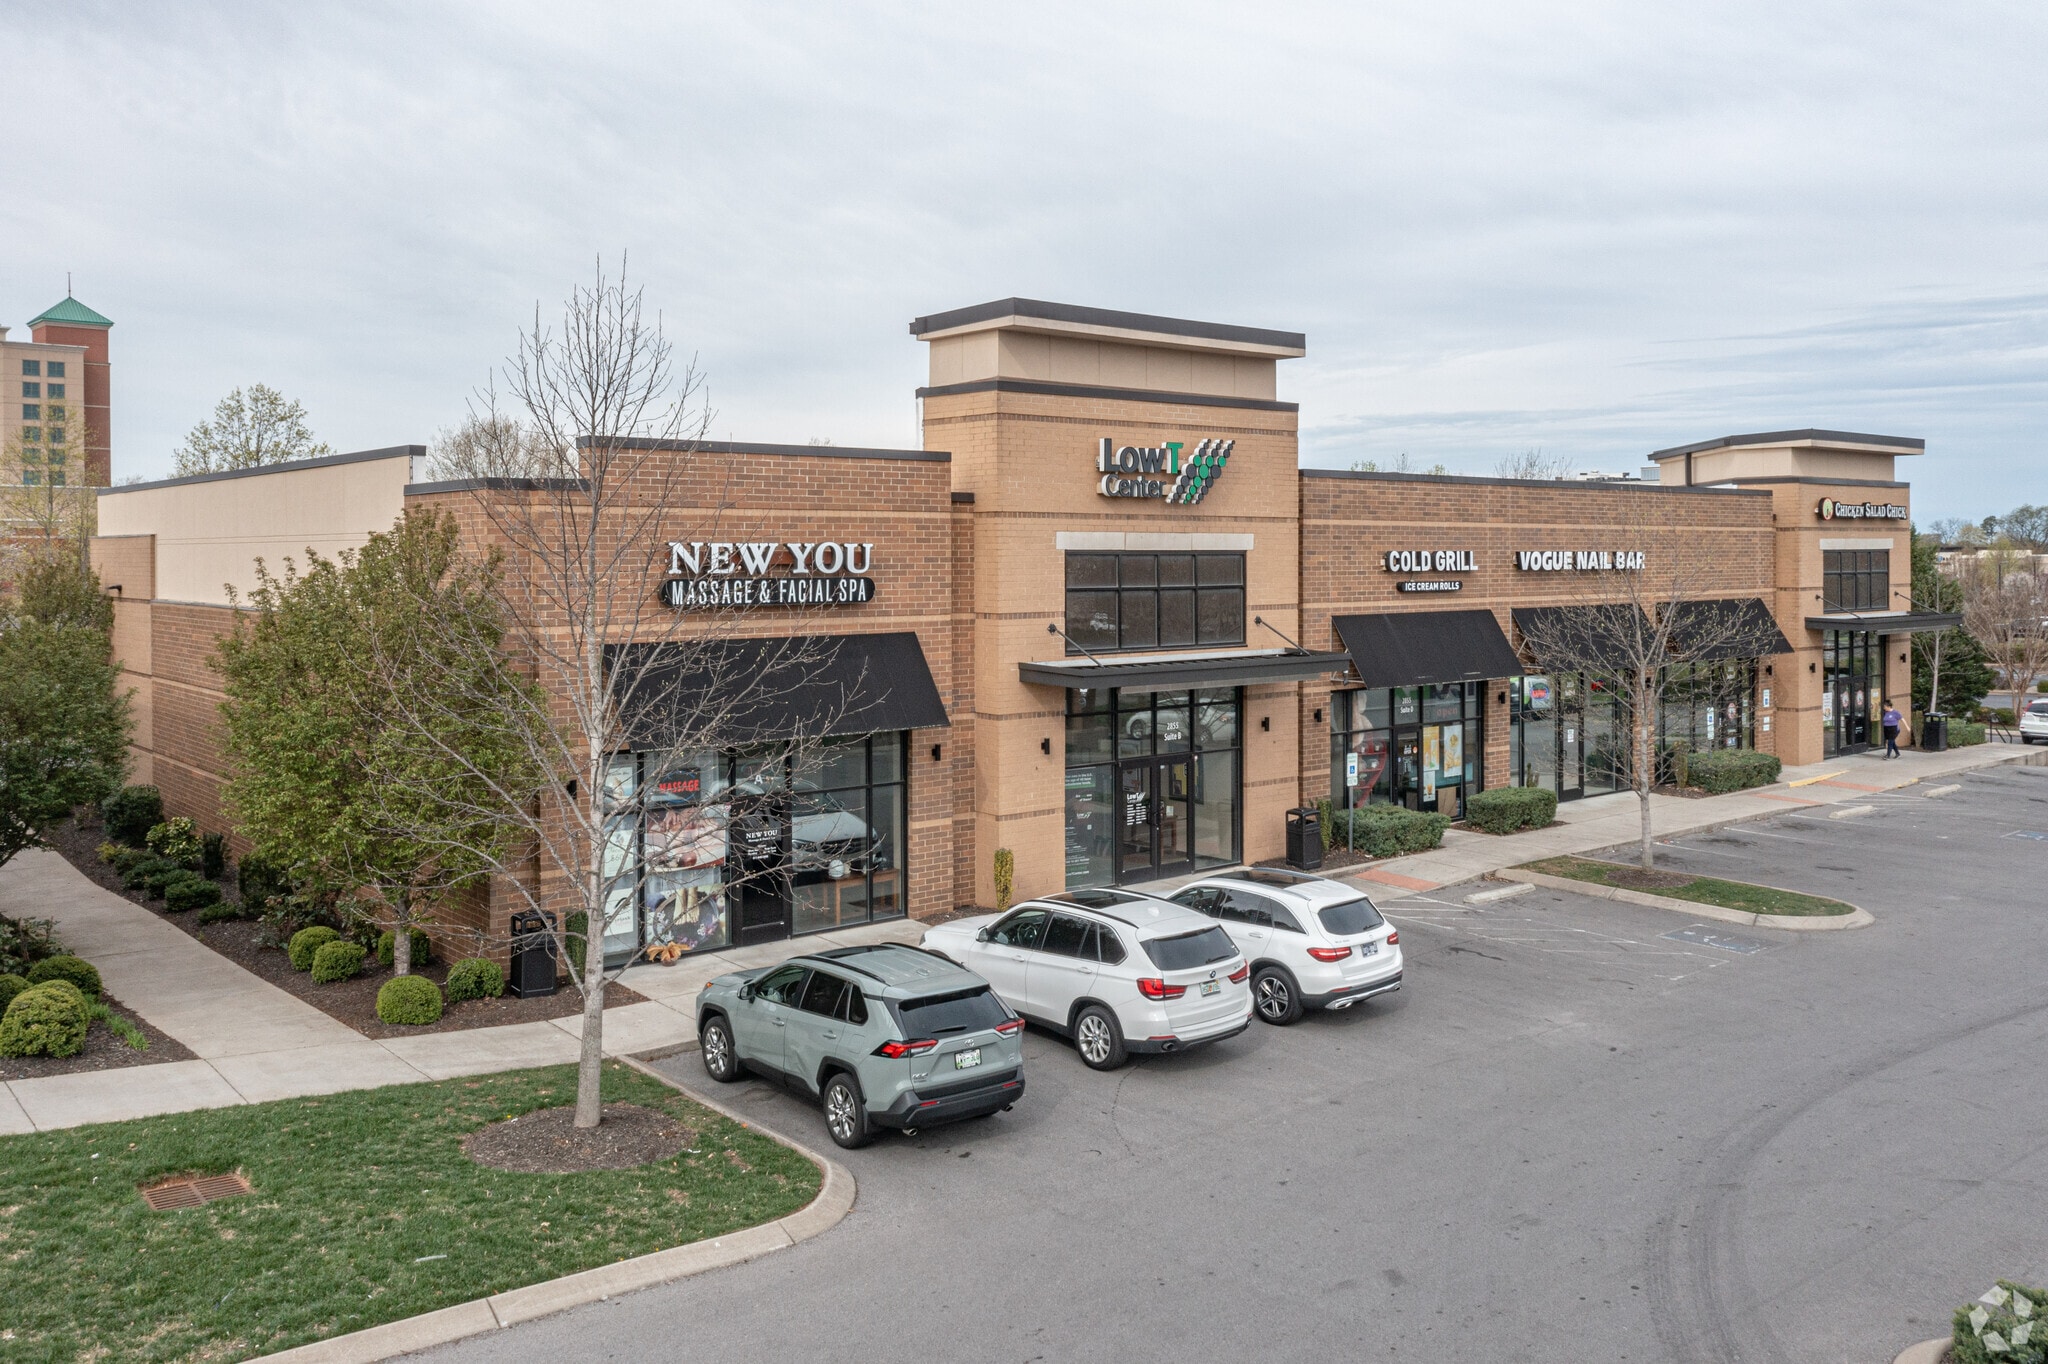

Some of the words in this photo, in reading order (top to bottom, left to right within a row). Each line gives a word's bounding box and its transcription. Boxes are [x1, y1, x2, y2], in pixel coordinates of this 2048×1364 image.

[1102, 473, 1166, 498] Center
[668, 541, 779, 576] NEW
[787, 541, 874, 575] YOU
[1389, 550, 1432, 572] COLD
[1435, 550, 1479, 571] GRILL
[1520, 551, 1573, 571] VOGUE
[1576, 551, 1613, 570] NAIL
[1616, 551, 1645, 570] BAR
[672, 580, 753, 605] MASSAGE
[760, 580, 771, 604] &
[779, 579, 833, 603] FACIAL
[839, 578, 867, 602] SPA
[1405, 582, 1416, 592] ICE
[1416, 582, 1439, 591] CREAM
[1439, 582, 1460, 590] ROLLS
[1166, 722, 1180, 730] 2855
[1164, 732, 1177, 741] Suite
[659, 779, 700, 793] MASSAGE
[754, 774, 763, 785] A
[746, 831, 762, 840] NEW
